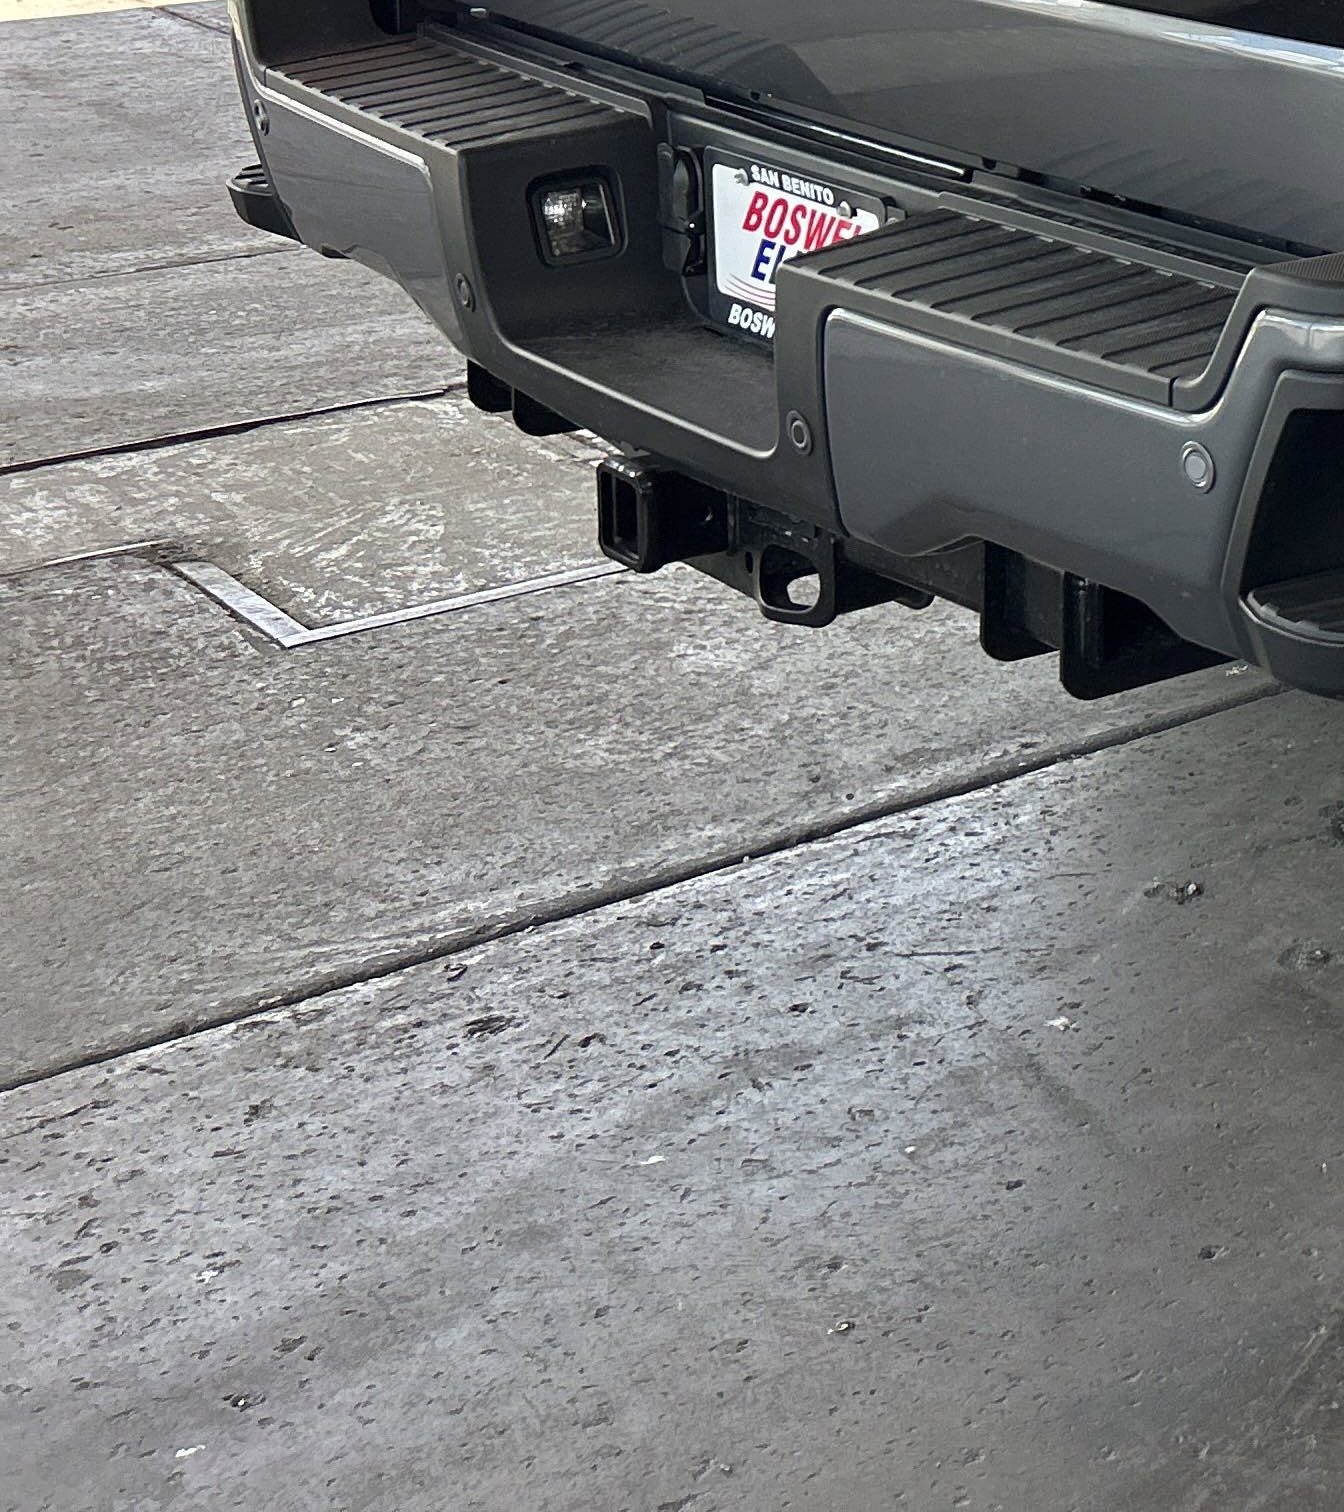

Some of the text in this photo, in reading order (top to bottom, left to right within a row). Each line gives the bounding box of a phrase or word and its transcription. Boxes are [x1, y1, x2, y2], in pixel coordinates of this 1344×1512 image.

[751, 164, 834, 205] SAN BENITO
[742, 191, 862, 250] BOSWE
